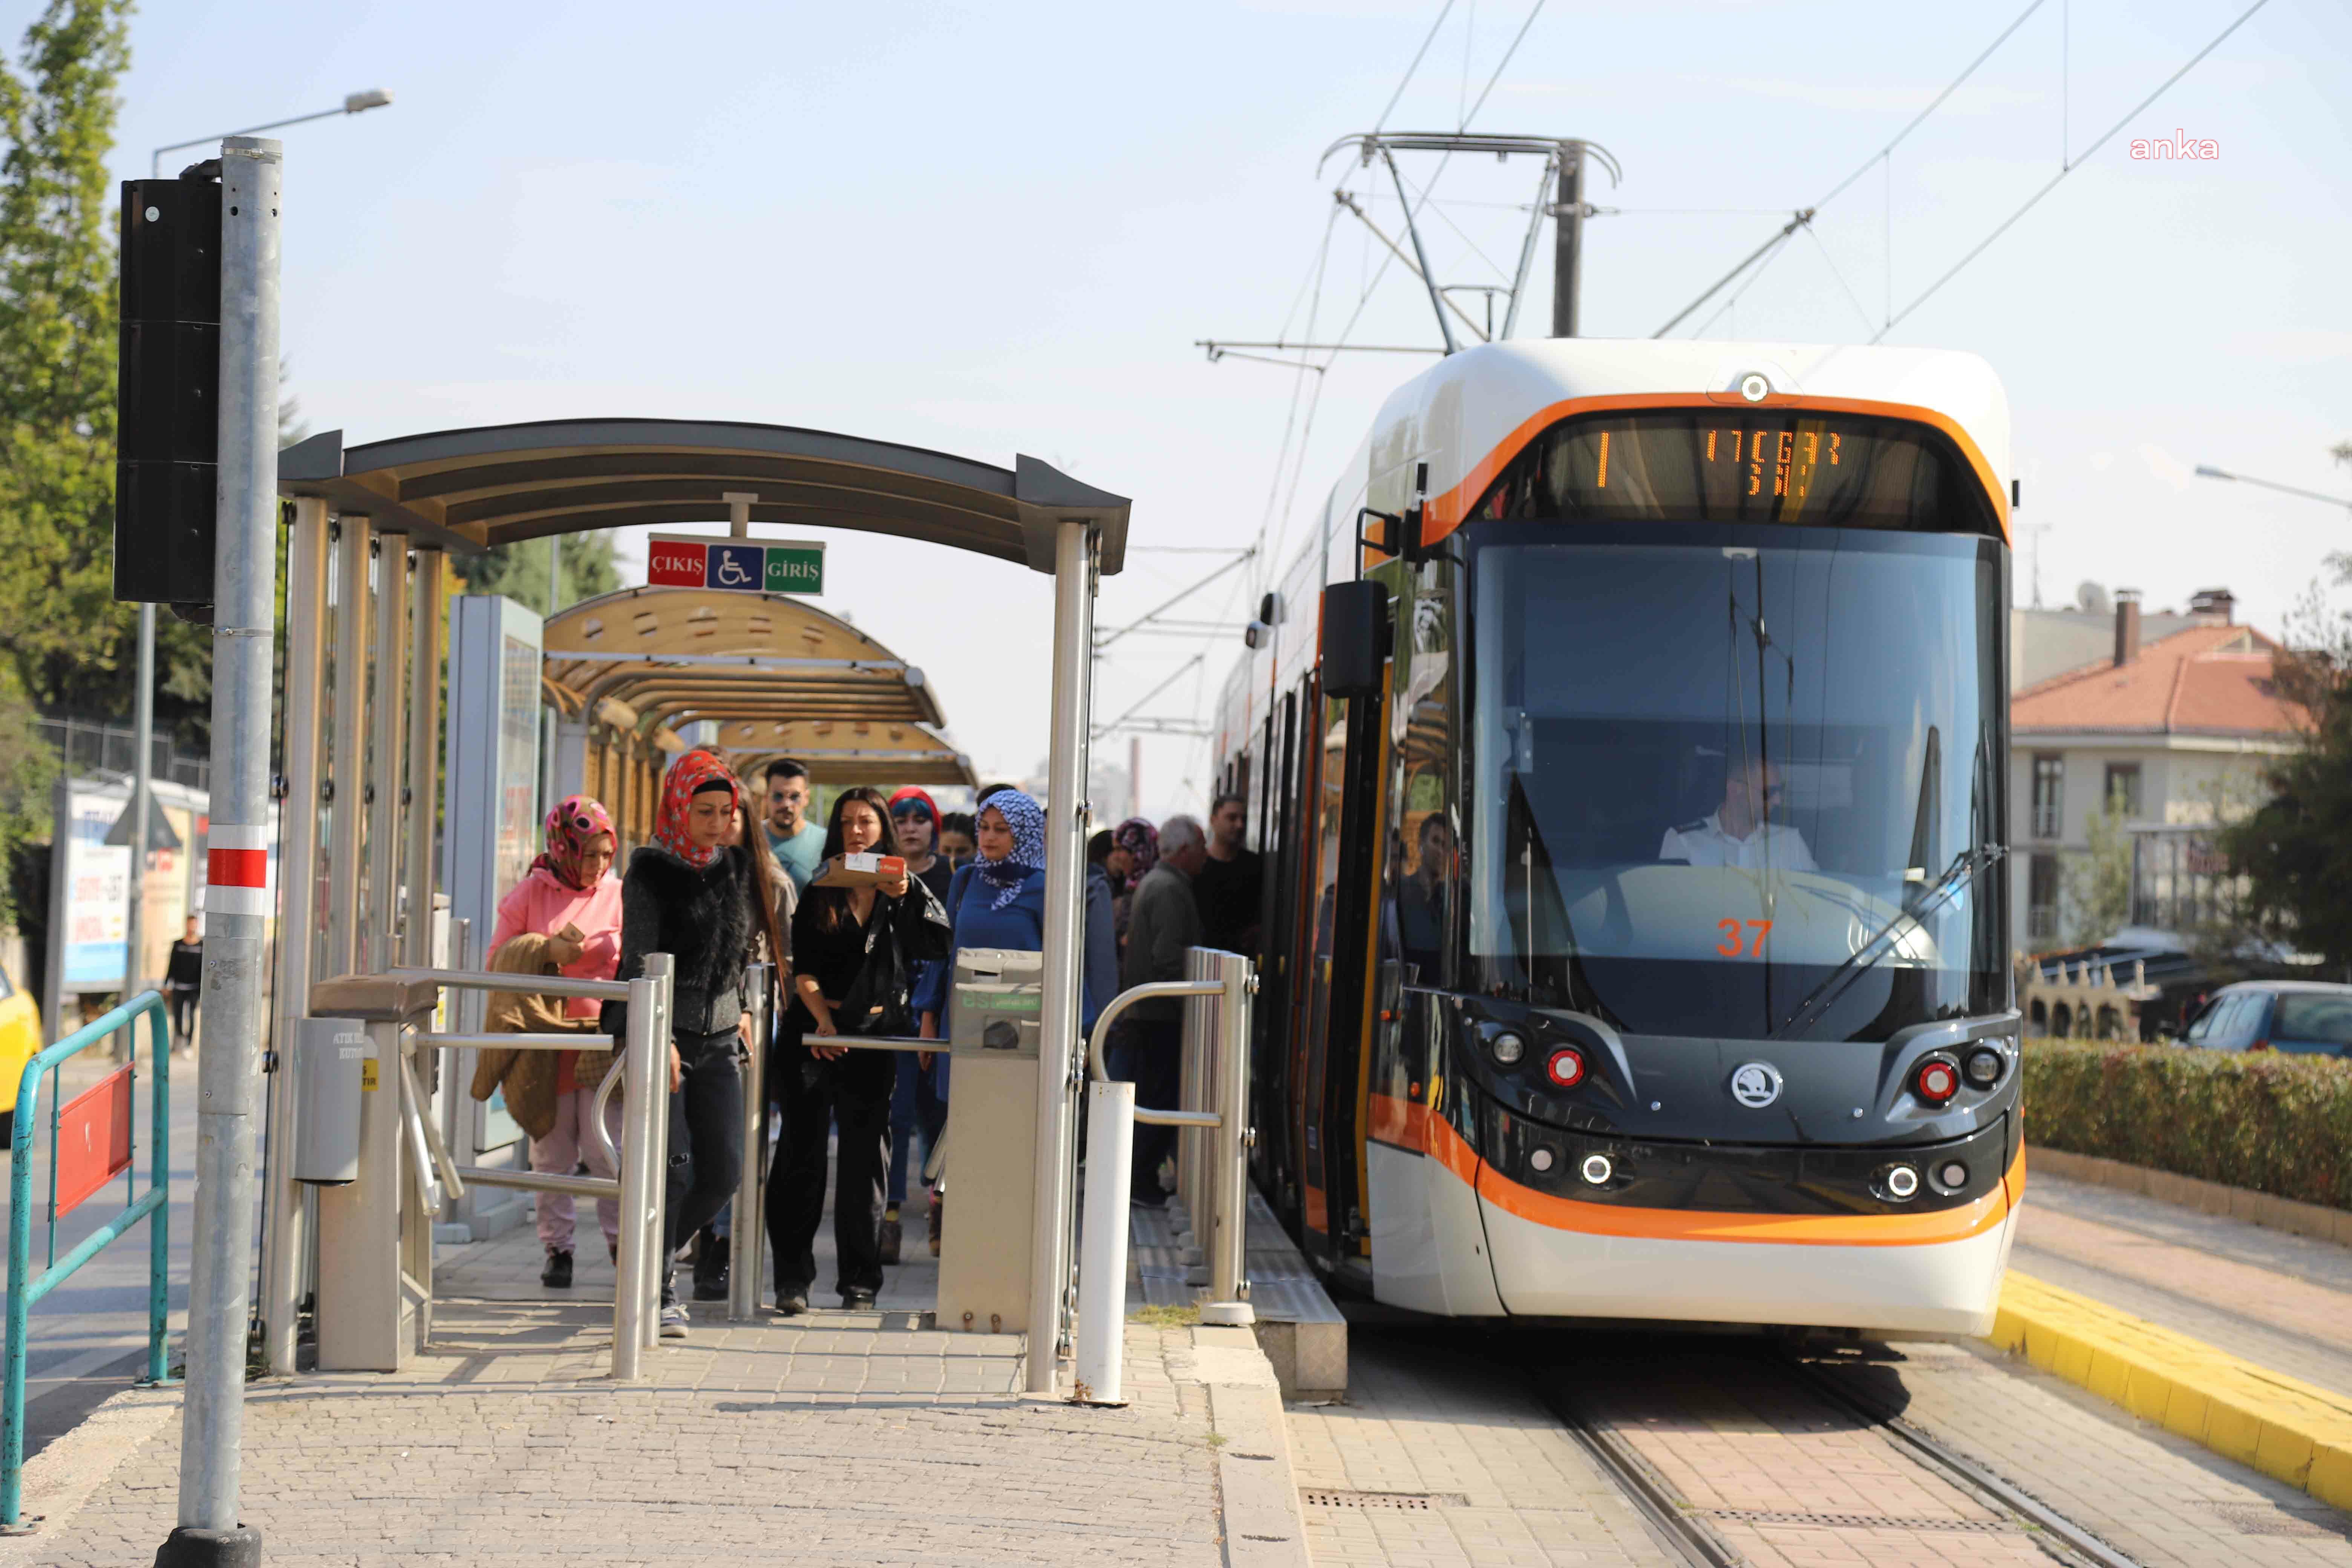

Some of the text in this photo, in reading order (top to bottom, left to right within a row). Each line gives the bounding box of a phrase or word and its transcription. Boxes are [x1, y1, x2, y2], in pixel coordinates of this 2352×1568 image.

[652, 556, 703, 575] ÇIKIŞ
[767, 560, 819, 582] GİRİŞ
[1716, 918, 1773, 958] 37
